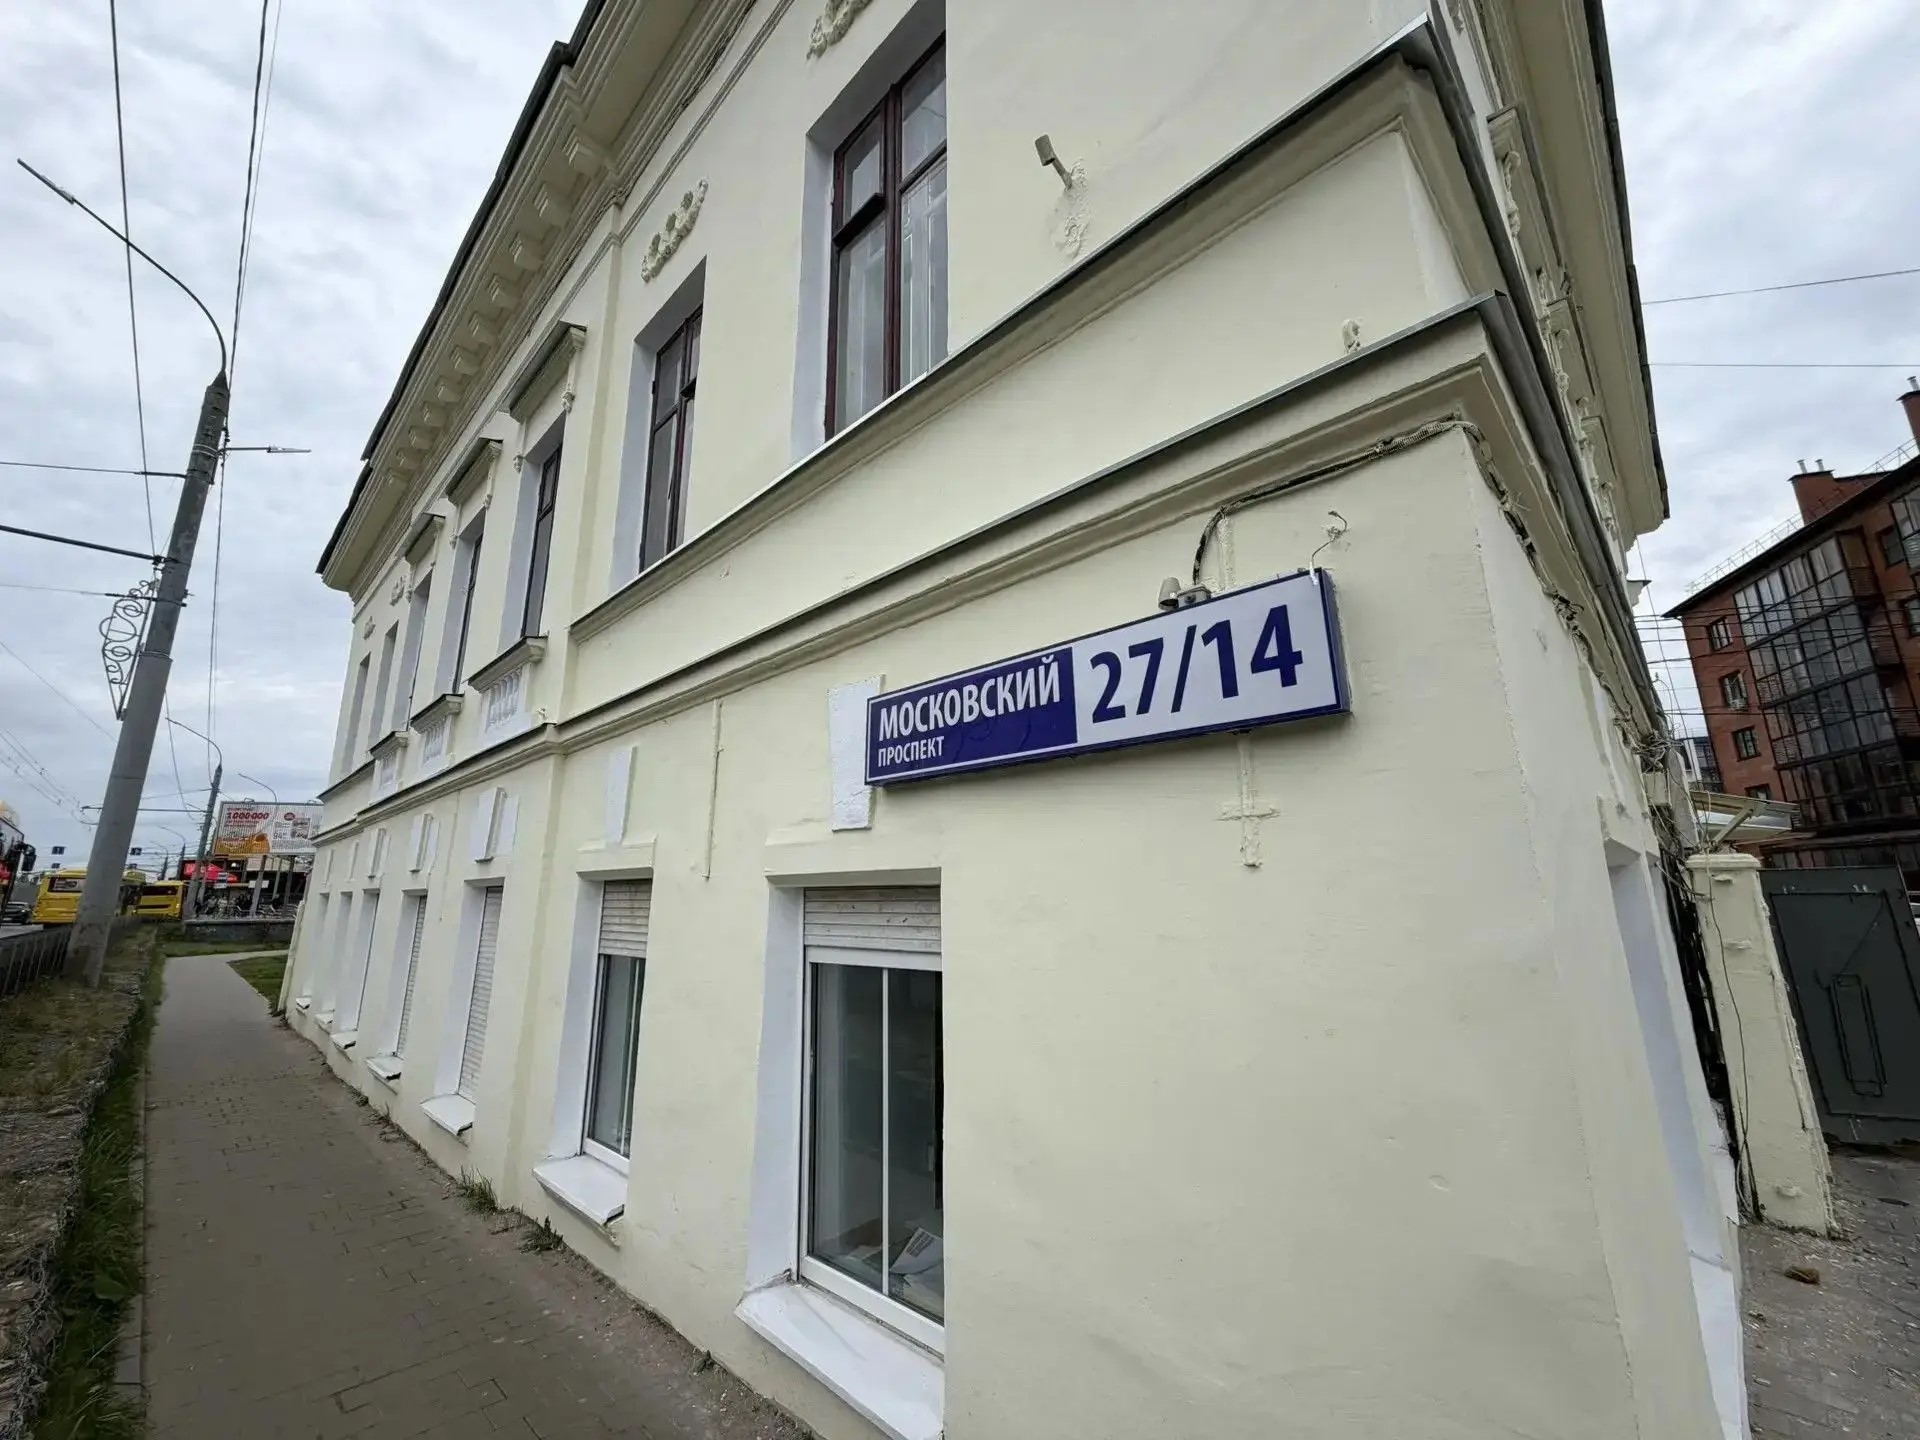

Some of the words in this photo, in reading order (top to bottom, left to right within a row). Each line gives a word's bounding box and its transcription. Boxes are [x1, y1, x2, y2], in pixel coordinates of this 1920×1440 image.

[878, 656, 1060, 742] МОСКОВСКИЙ
[1090, 604, 1303, 723] 27/14
[877, 735, 945, 767] ПРОСПЕКТ
